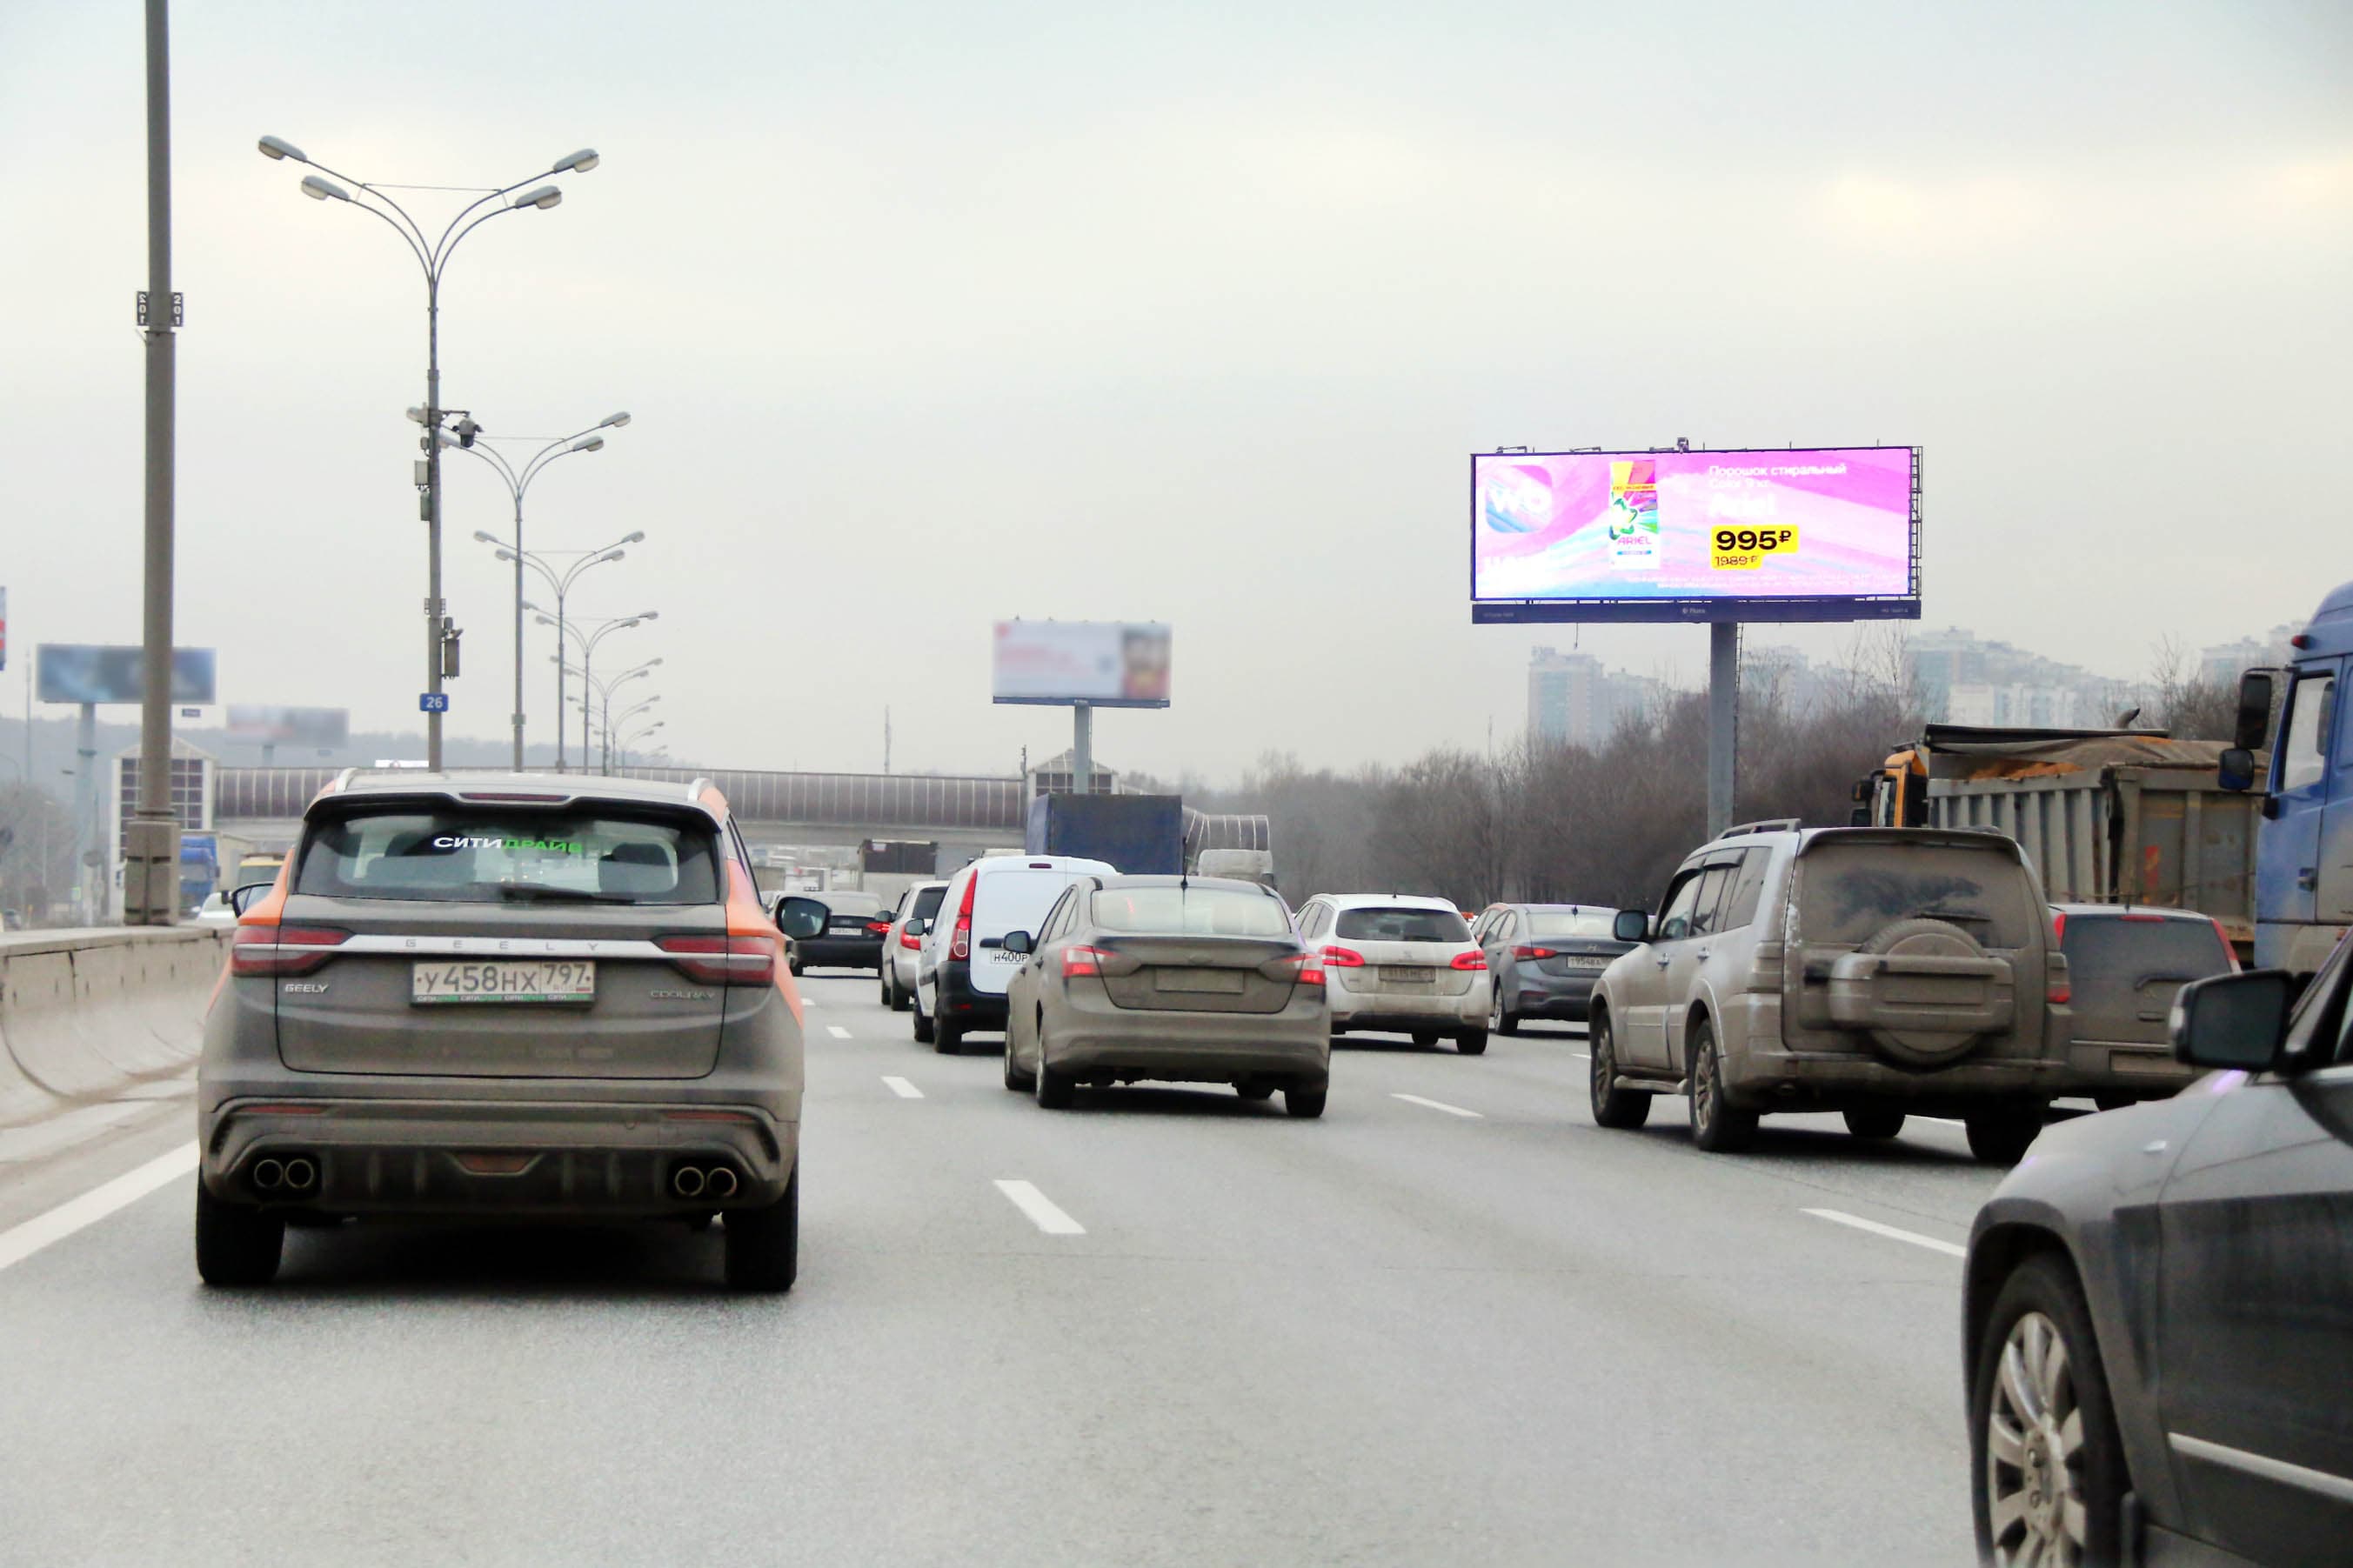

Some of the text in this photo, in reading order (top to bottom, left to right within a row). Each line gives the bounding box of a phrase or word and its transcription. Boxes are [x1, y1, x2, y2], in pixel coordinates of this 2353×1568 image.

[1708, 462, 1847, 477] Порошок стиральный
[1617, 536, 1653, 545] ARIEL
[426, 696, 443, 709] 26
[404, 938, 598, 951] GEELY
[544, 964, 587, 984] 797
[285, 984, 329, 993] GEELY
